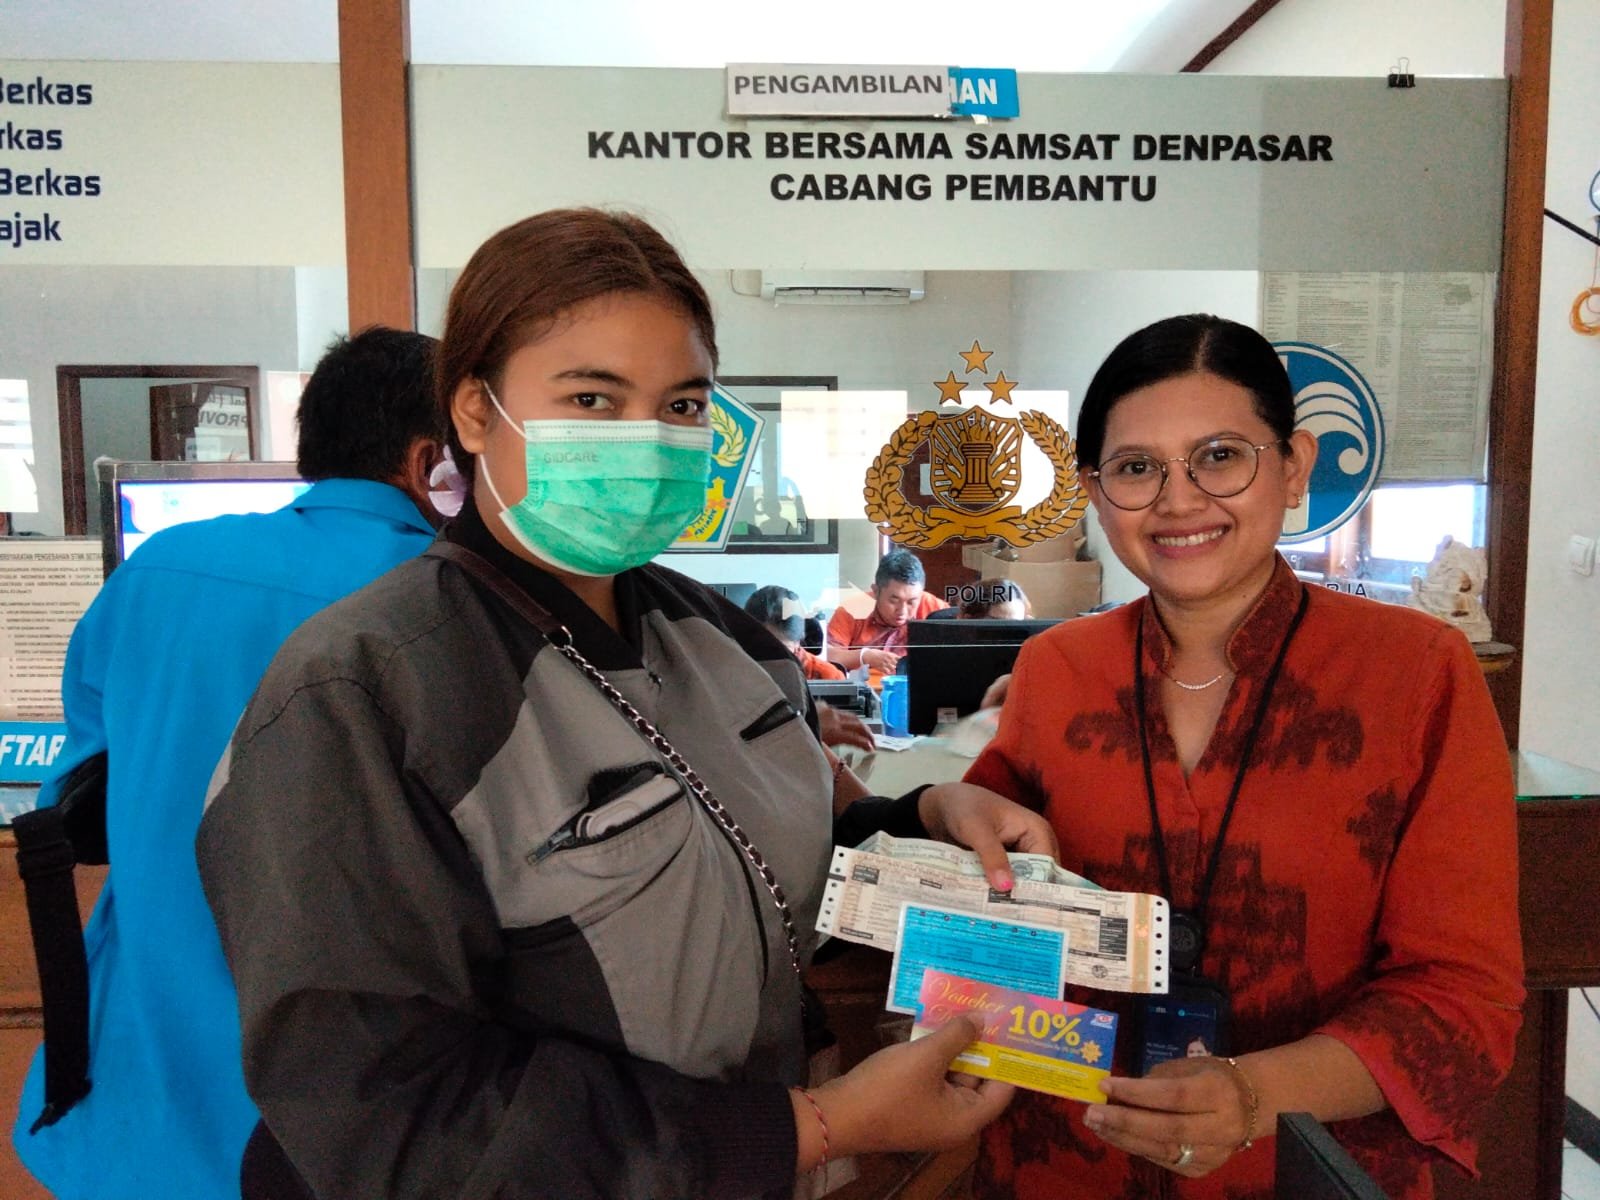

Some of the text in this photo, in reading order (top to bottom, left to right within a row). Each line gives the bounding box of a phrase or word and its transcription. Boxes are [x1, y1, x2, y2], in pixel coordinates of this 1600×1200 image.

[0, 76, 93, 106] erkas
[735, 75, 943, 95] PENGAMBILAN
[588, 131, 1334, 163] KANTOR BERSAMA SAMSAT DENPASAR
[0, 167, 101, 197] Berkas
[770, 173, 1157, 202] CABANG PEMBANTU
[945, 585, 1013, 603] POLRI
[0, 734, 67, 766] FTAR
[928, 976, 1006, 1013] Voucher
[1008, 1004, 1082, 1047] 10%
